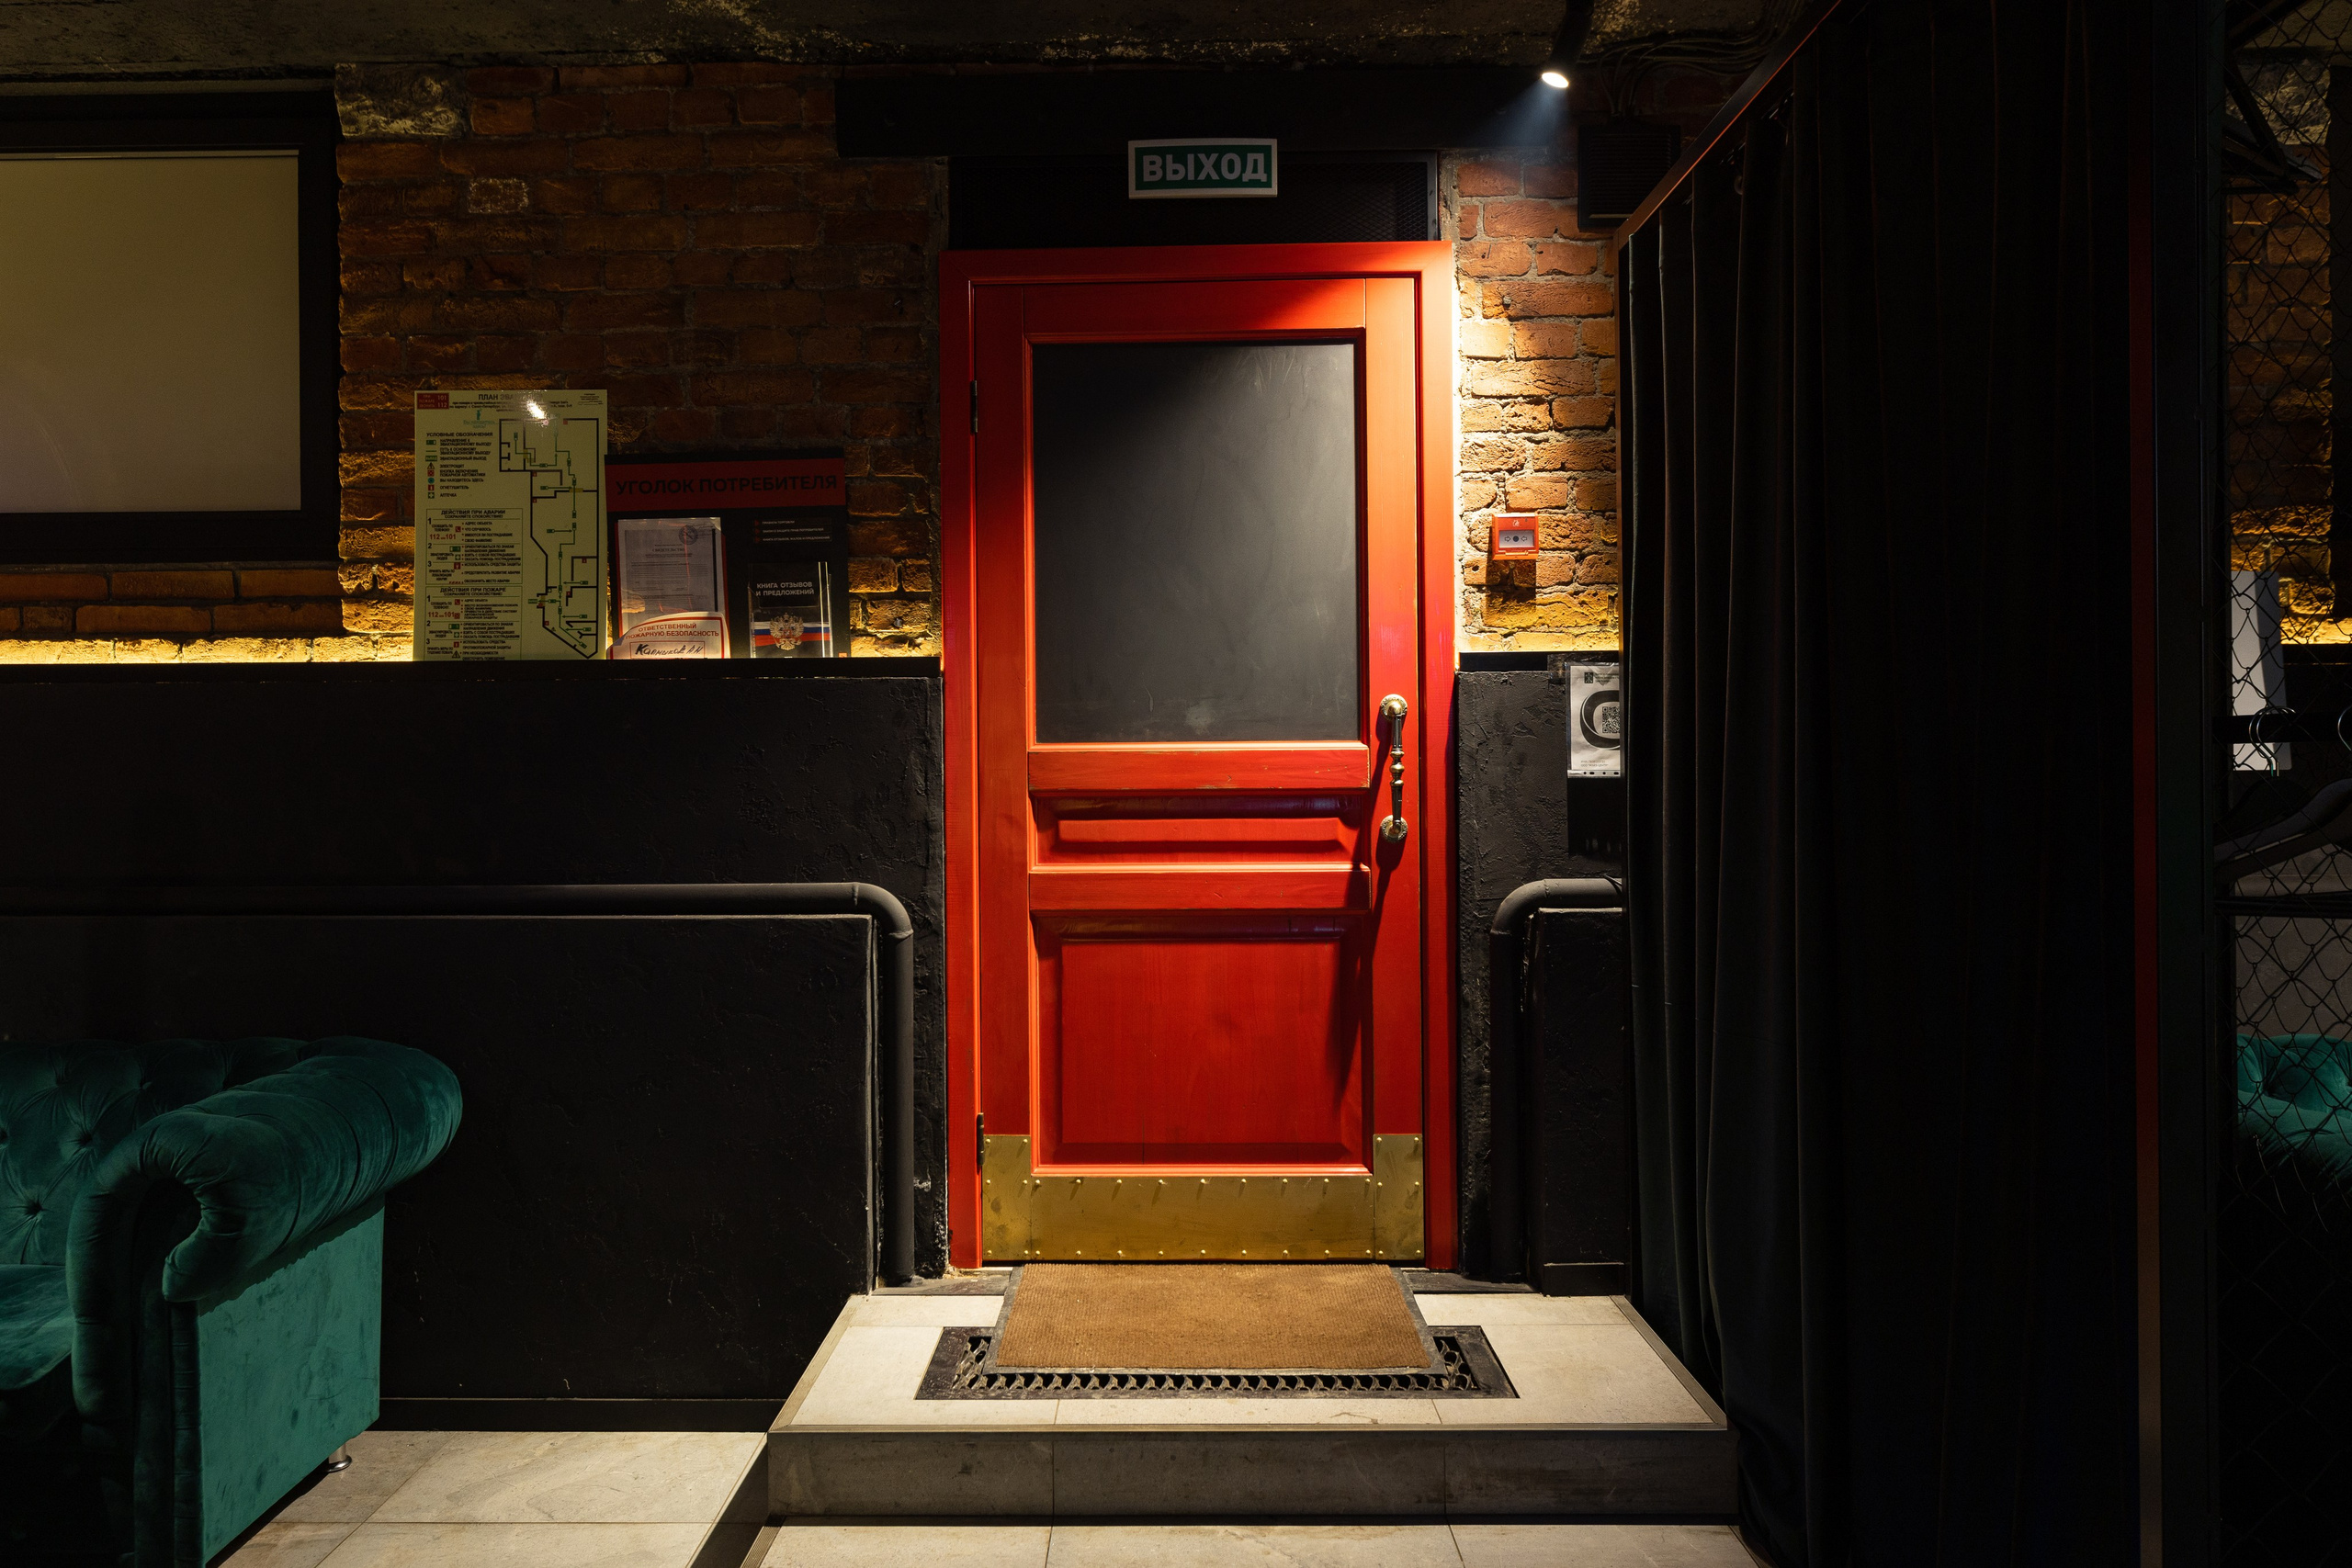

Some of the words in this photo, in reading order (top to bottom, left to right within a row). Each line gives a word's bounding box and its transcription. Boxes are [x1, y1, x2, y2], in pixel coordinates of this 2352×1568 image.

[1143, 152, 1267, 182] ВЫХОД
[616, 479, 694, 495] УГОЛОК
[699, 475, 837, 493] ПОТРЕБИТЕЛЯ
[763, 588, 815, 596] ПРЕДЛОЖЕНИЙ
[639, 623, 696, 632] ОТВЕТСТВЕННЫЙ
[626, 631, 664, 639] ПОЖАРНУЮ
